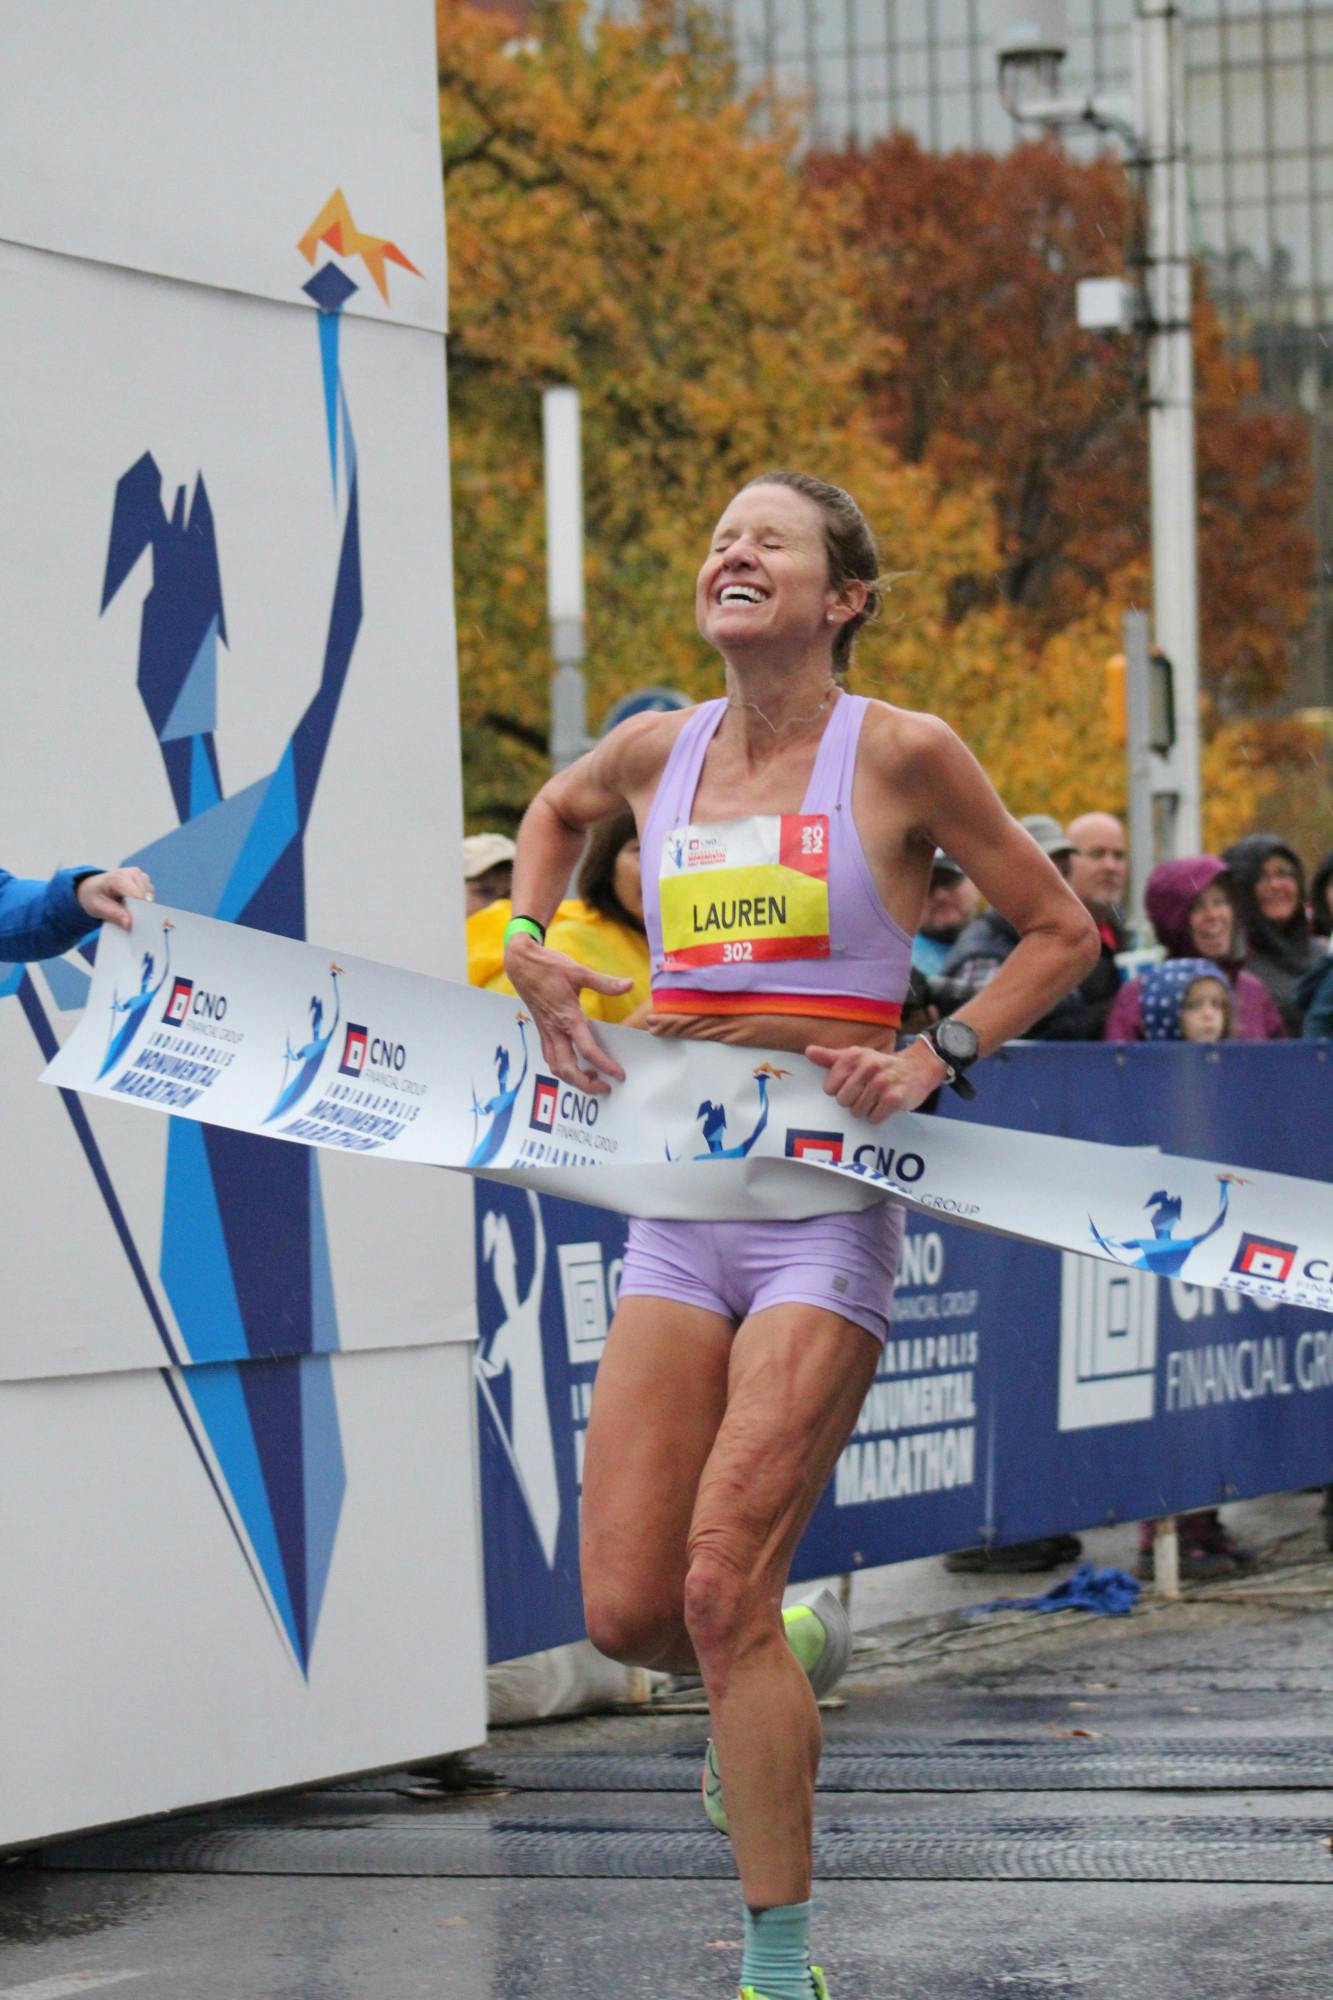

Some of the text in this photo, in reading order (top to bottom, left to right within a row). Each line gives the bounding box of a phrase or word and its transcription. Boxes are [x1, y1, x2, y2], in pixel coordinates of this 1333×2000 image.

[693, 896, 786, 933] LAUREN
[722, 942, 752, 962] 302
[193, 990, 227, 1021] CNO
[132, 1048, 221, 1087] MONUMENTAL
[147, 1031, 235, 1067] INDIANAPOLIS
[370, 1038, 406, 1071] CNO
[109, 1070, 205, 1109] MARATHON
[324, 1082, 421, 1122] INDIANAPOLIS
[561, 1091, 599, 1126] CNO
[276, 1118, 386, 1151] MARATHON
[305, 1099, 406, 1141] MONUMENTAL
[853, 1144, 925, 1182] CNO
[920, 1193, 981, 1216] GROUP
[894, 1231, 944, 1287] NO
[1165, 1336, 1293, 1412] FINANCIAL
[853, 1371, 976, 1436] ONUMENTAL
[834, 1426, 976, 1507] MARATHON
